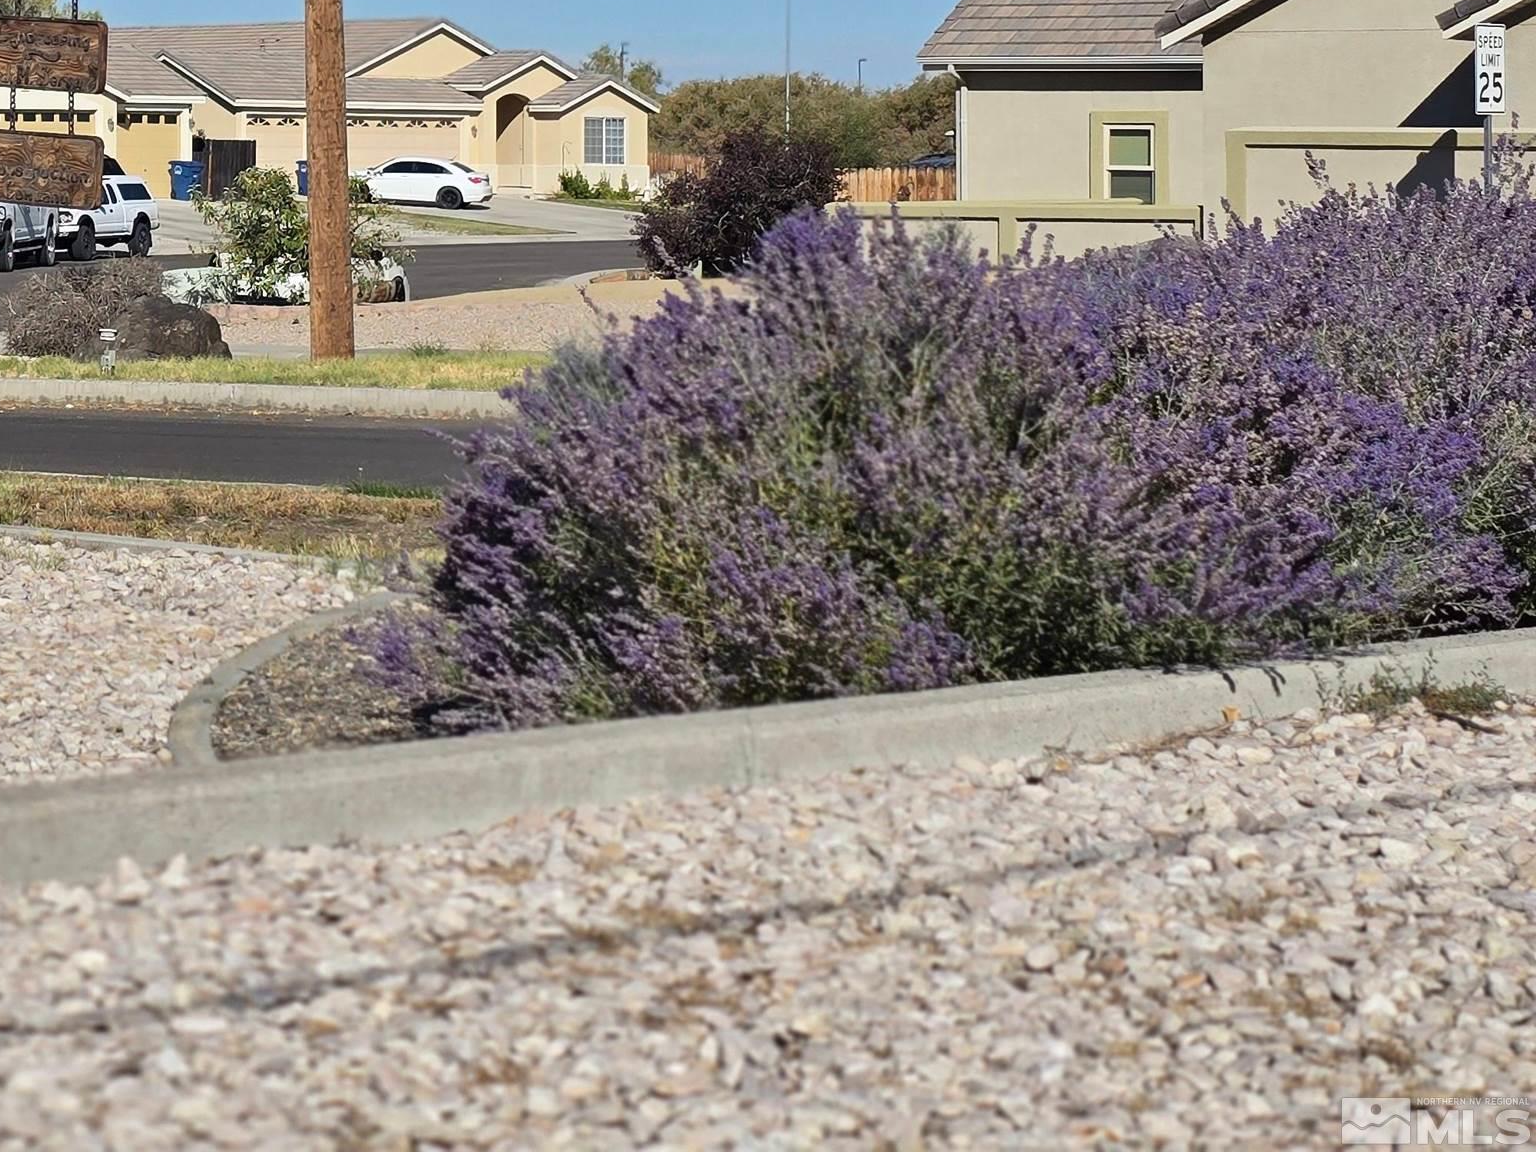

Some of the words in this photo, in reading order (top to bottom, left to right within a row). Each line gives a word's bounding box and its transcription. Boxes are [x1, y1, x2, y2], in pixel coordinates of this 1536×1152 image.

[1478, 35, 1503, 49] SPEED
[1480, 53, 1501, 67] LIMIT
[1479, 72, 1503, 103] 25
